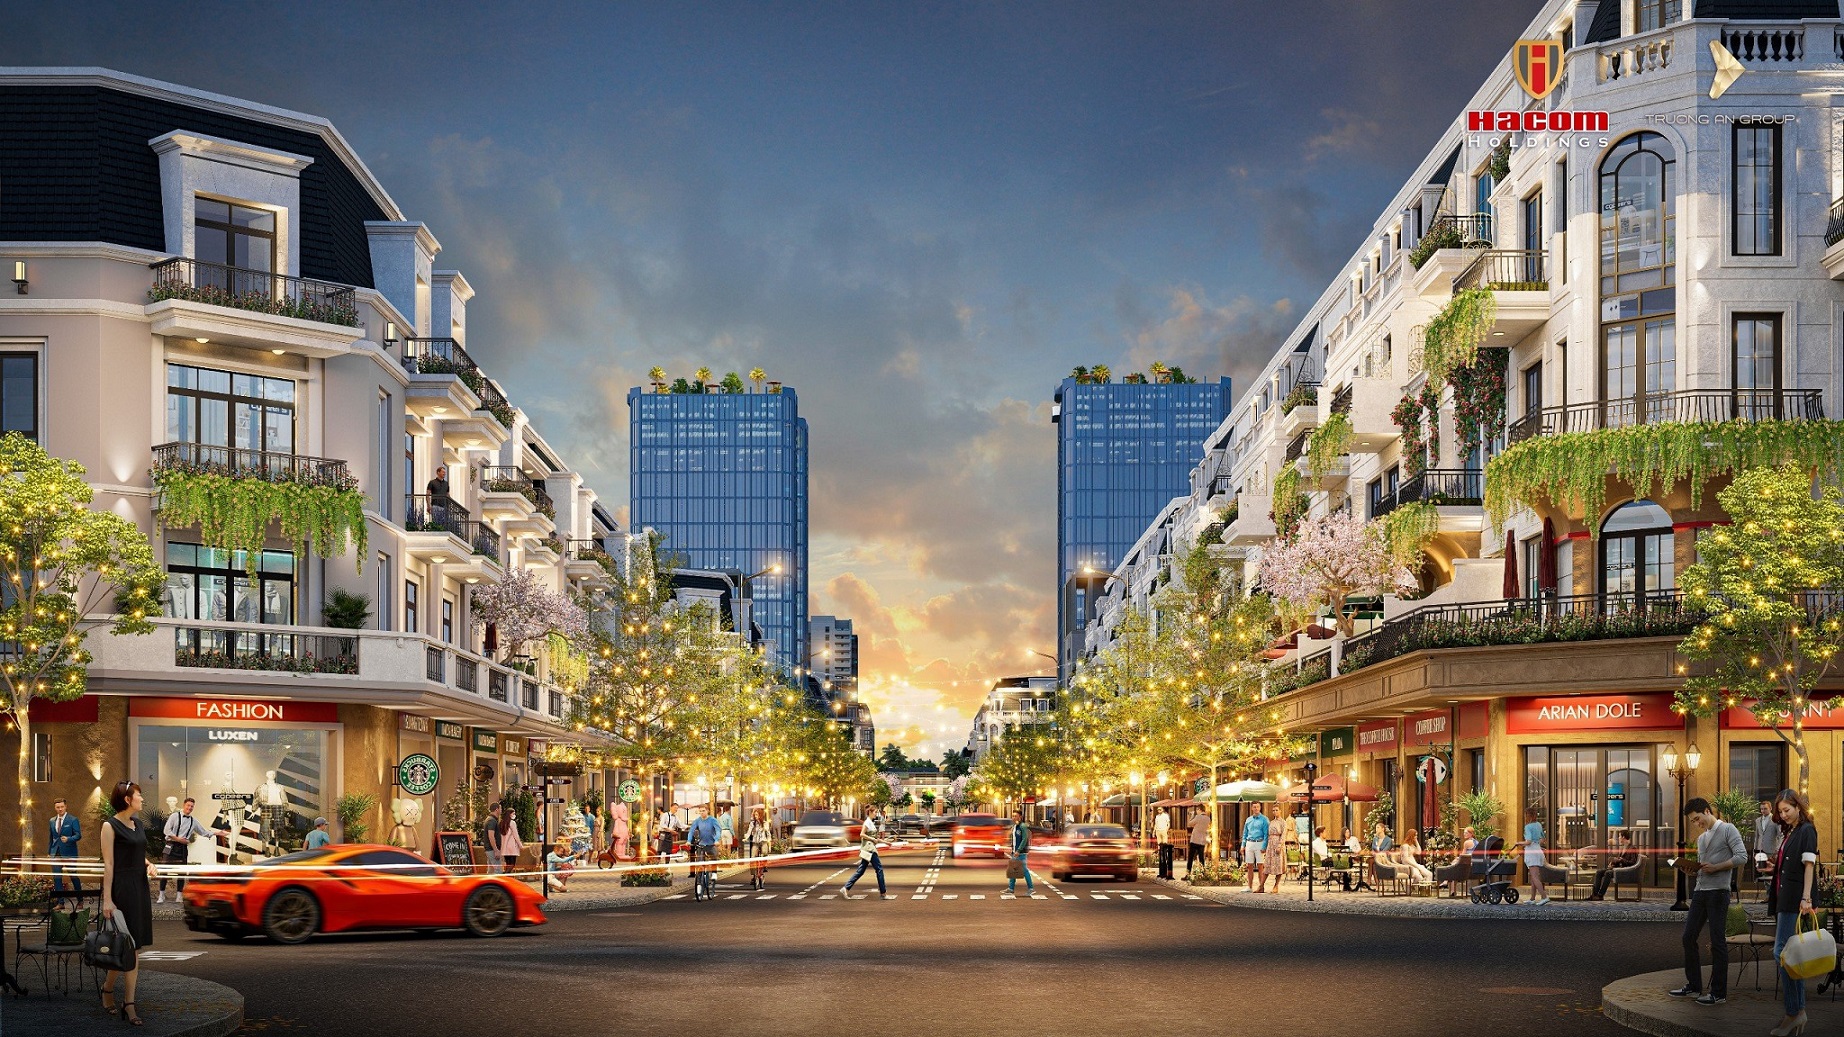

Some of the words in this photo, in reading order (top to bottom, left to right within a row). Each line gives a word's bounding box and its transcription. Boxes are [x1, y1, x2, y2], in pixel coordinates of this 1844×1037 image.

[196, 702, 284, 719] FASHION
[1537, 704, 1590, 720] ARIAN
[1596, 702, 1642, 719] DOLE
[208, 730, 259, 741] LUXEN
